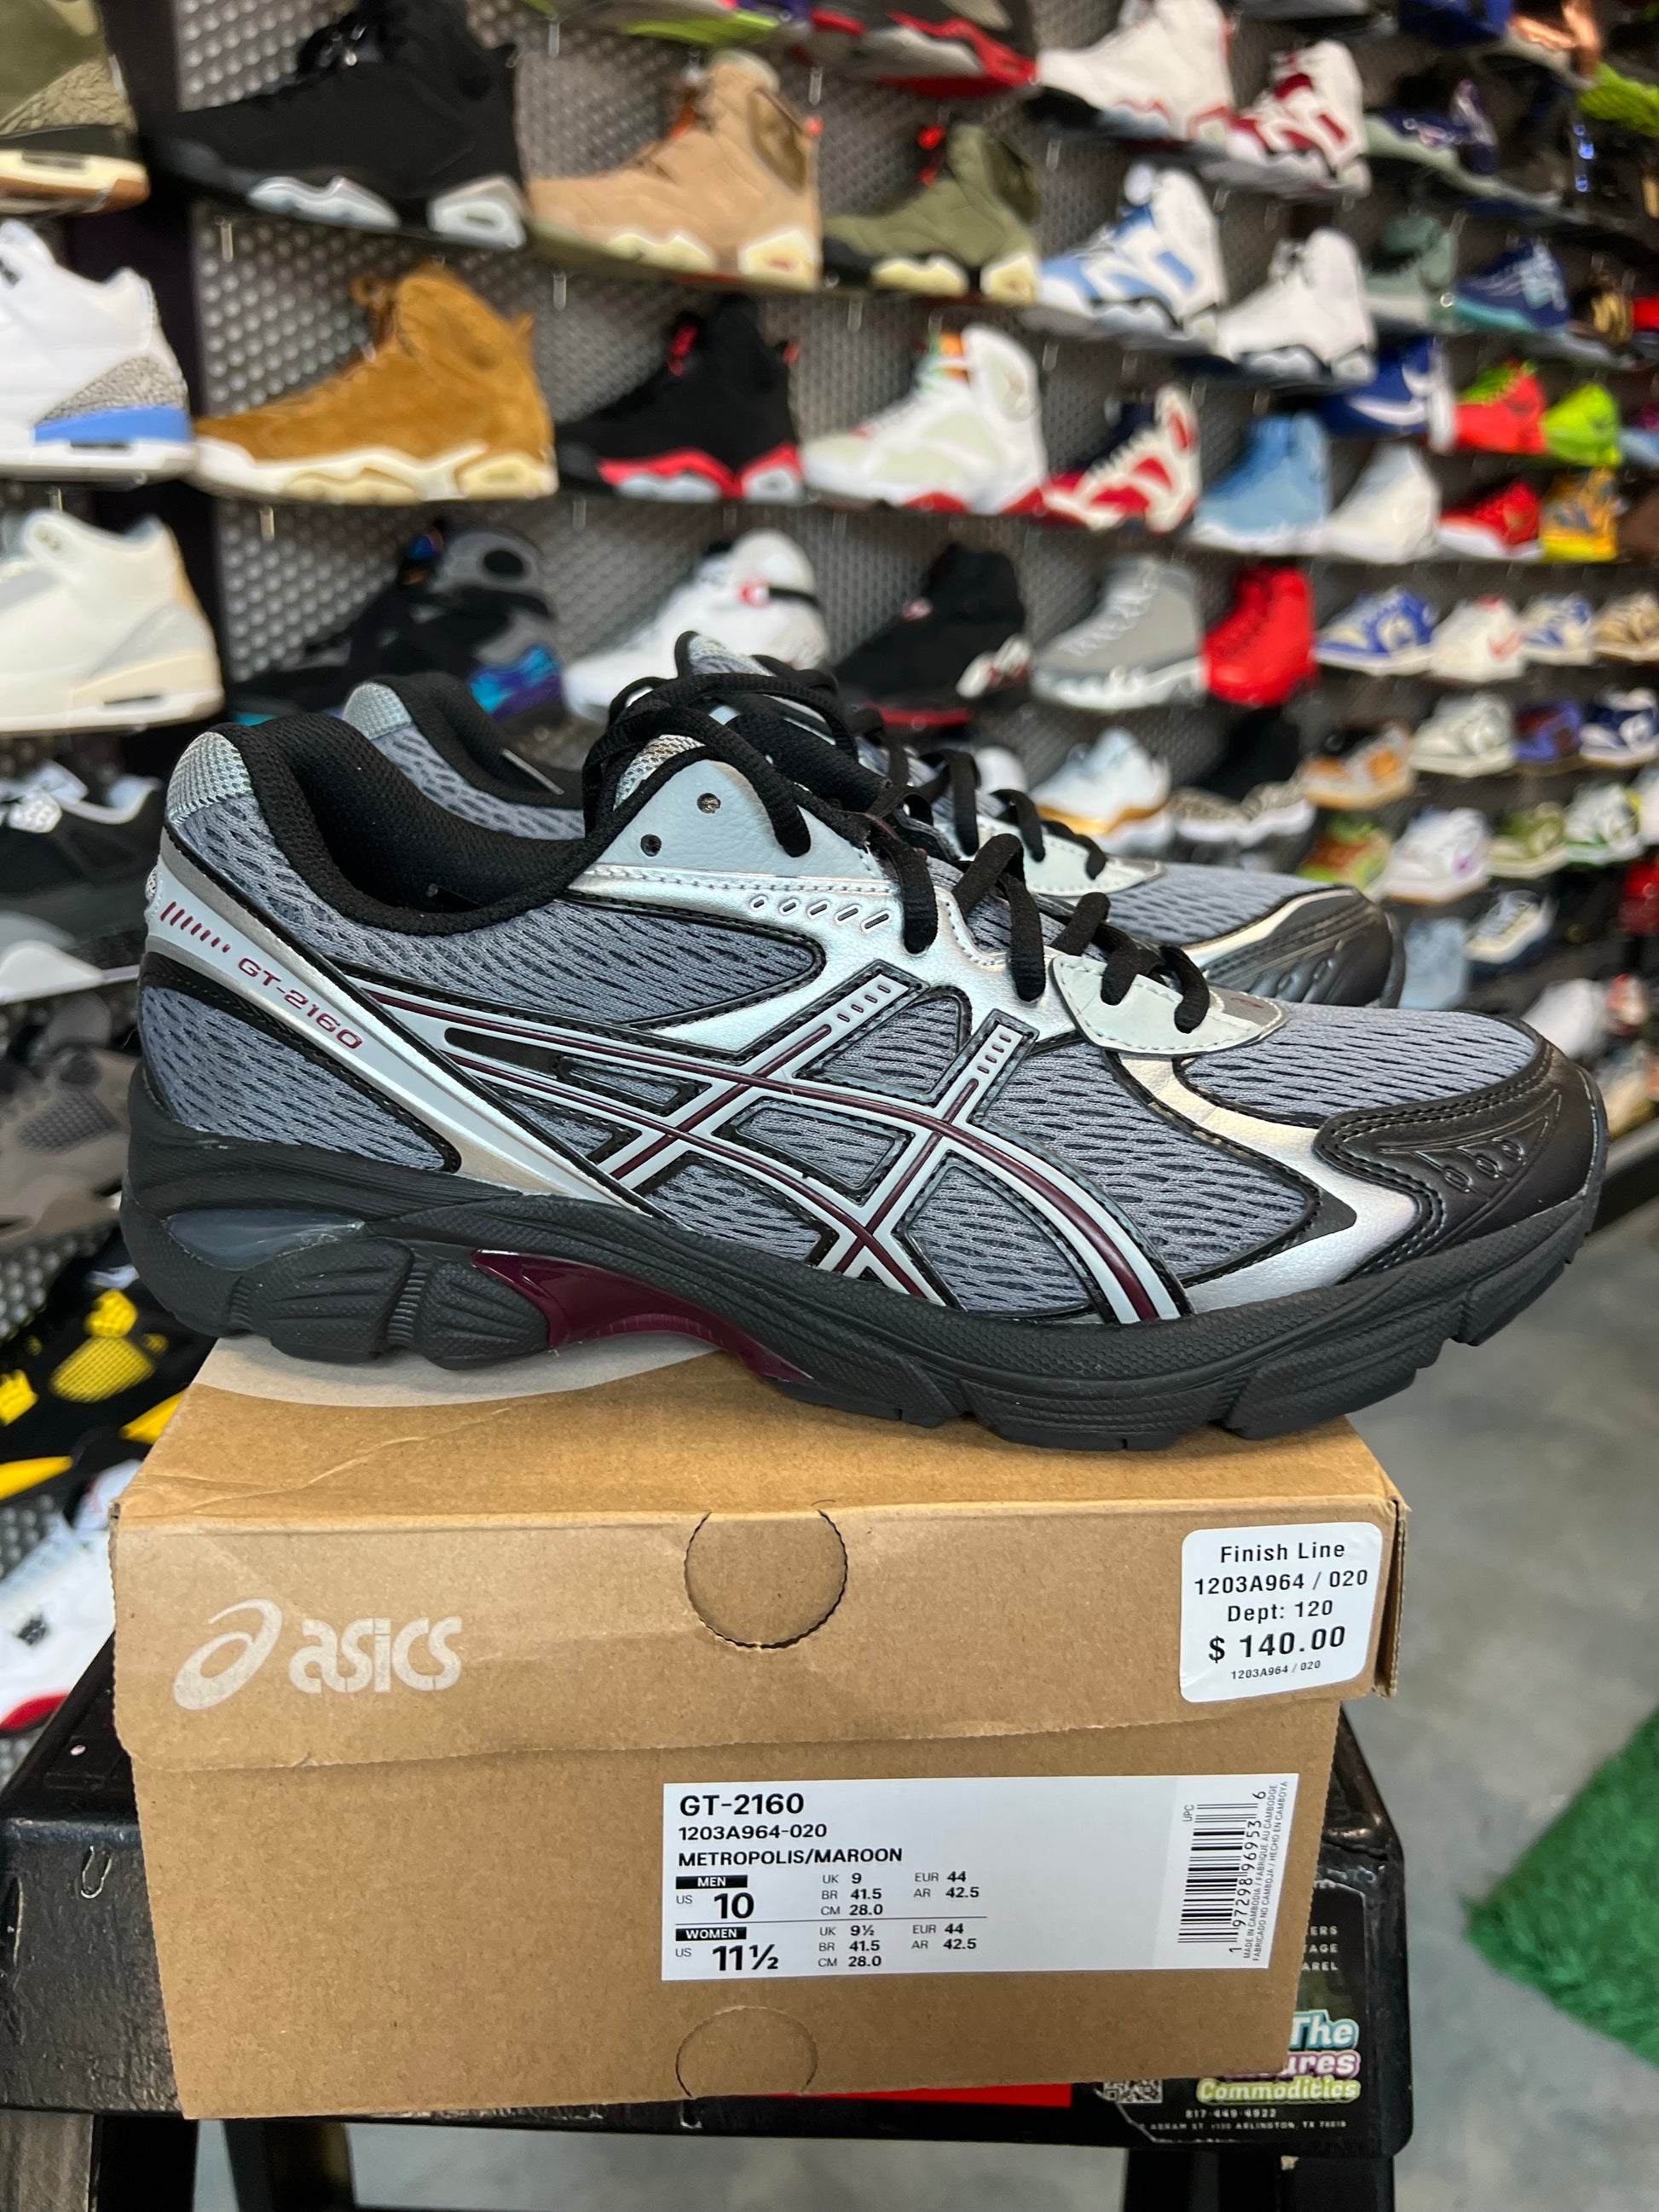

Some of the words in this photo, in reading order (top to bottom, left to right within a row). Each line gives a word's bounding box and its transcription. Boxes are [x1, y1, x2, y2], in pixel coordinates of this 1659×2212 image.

[238, 957, 363, 1049] GT-2160
[1221, 1543, 1287, 1562] Finish
[1298, 1542, 1345, 1559] Line
[1194, 1574, 1304, 1595] 1203A964
[1312, 1572, 1321, 1590] /
[1329, 1569, 1368, 1587] 020
[1228, 1604, 1284, 1624] Dept:
[1295, 1600, 1332, 1618] 120
[1240, 1626, 1345, 1658] 140.00
[289, 1616, 462, 1694] asics
[1231, 1666, 1288, 1679] 1203A964
[1301, 1660, 1321, 1670] 020
[680, 1793, 804, 1816] GT-2160
[1264, 1785, 1277, 1828] CAMBODGE
[1275, 1782, 1288, 1820] CAMBOYA
[1182, 1804, 1194, 1822] UPC
[679, 1823, 826, 1840] 1203A964-020
[1262, 1831, 1269, 1840] AU
[1274, 1822, 1281, 1833] EN
[1269, 1834, 1280, 1861] HECHO
[679, 1848, 902, 1866] METROPOLIS/MAROON
[697, 1877, 726, 1887] MEN
[823, 1874, 839, 1884] UK
[852, 1873, 862, 1884] 9
[915, 1872, 939, 1882] EUR
[947, 1871, 966, 1882] 44
[822, 1891, 837, 1900] BR
[850, 1888, 882, 1900] 41.5
[914, 1888, 930, 1897] AR
[945, 1887, 980, 1898] 42.5
[1263, 1868, 1275, 1905] CAMBOJA
[676, 1895, 692, 1904] US
[714, 1892, 754, 1919] 10
[821, 1906, 840, 1916] CM
[849, 1904, 883, 1916] 28.0
[1248, 1888, 1262, 1927] CAMBODIA
[1260, 1908, 1269, 1918] NO
[685, 1928, 737, 1939] WOMEN
[820, 1926, 835, 1936] UK
[912, 1925, 936, 1933] EUR
[945, 1923, 963, 1934] 44
[819, 1942, 835, 1951] BR
[849, 1940, 880, 1951] 41.5
[911, 1940, 928, 1949] AR
[943, 1938, 976, 1950] 42.5
[1244, 1938, 1253, 1958] MADE
[1253, 1920, 1266, 1961] FABRICADO
[675, 1948, 691, 1957] US
[818, 1958, 837, 1967] CM
[848, 1955, 882, 1967] 28.0
[1290, 2015, 1354, 2046] The
[1200, 2078, 1357, 2101] Commodities
